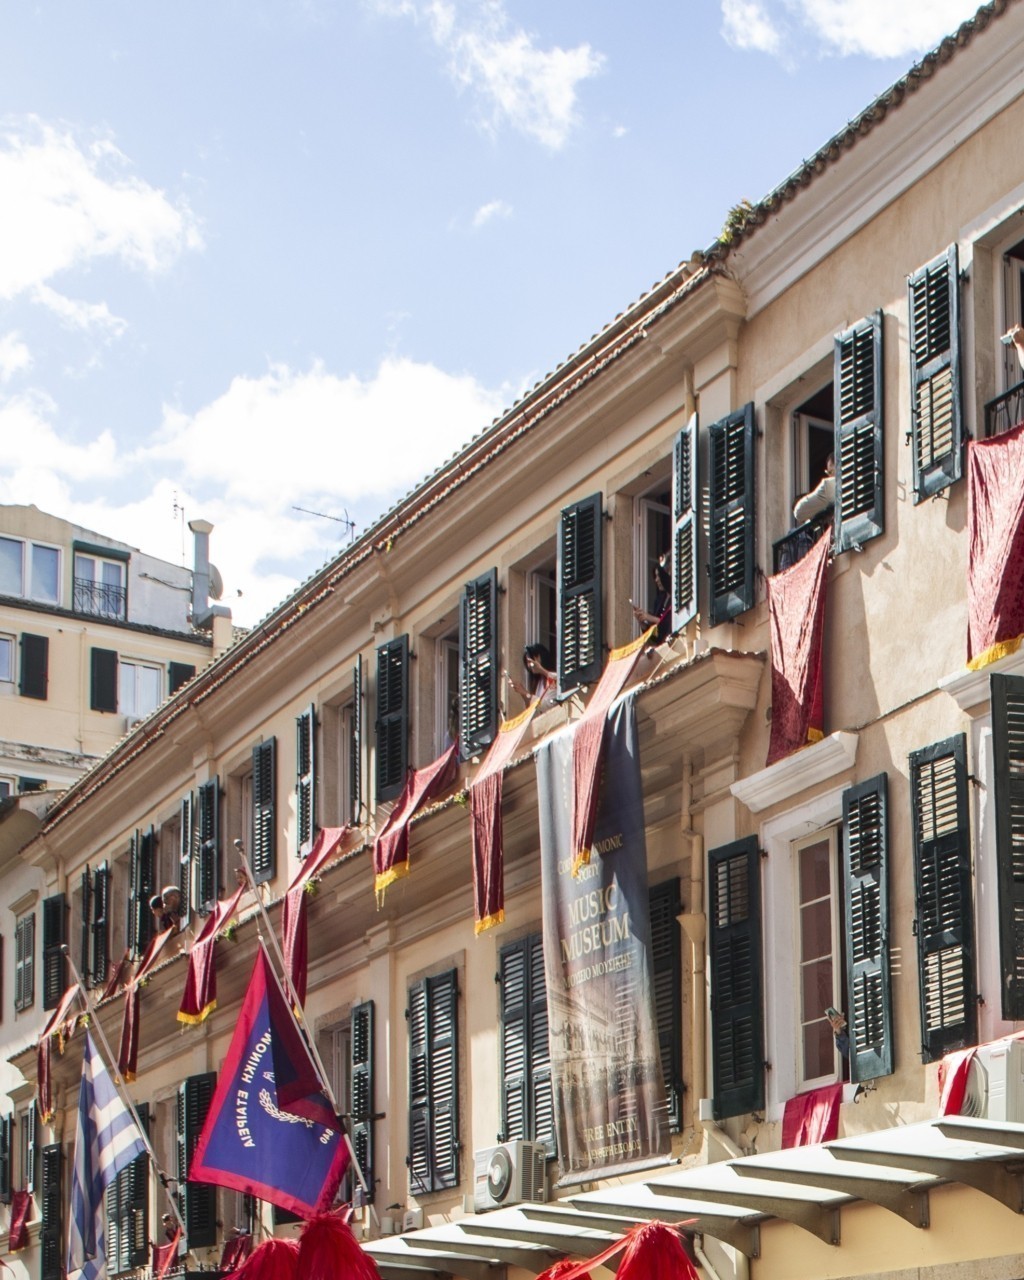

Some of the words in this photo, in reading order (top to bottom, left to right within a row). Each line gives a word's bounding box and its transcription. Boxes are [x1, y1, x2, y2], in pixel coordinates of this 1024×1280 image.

[576, 863, 599, 885] SOCIETY
[568, 884, 618, 929] MUSIC
[561, 912, 630, 963] MUSEUM
[583, 1124, 604, 1142] FREE
[606, 1117, 638, 1137] ENTRY
